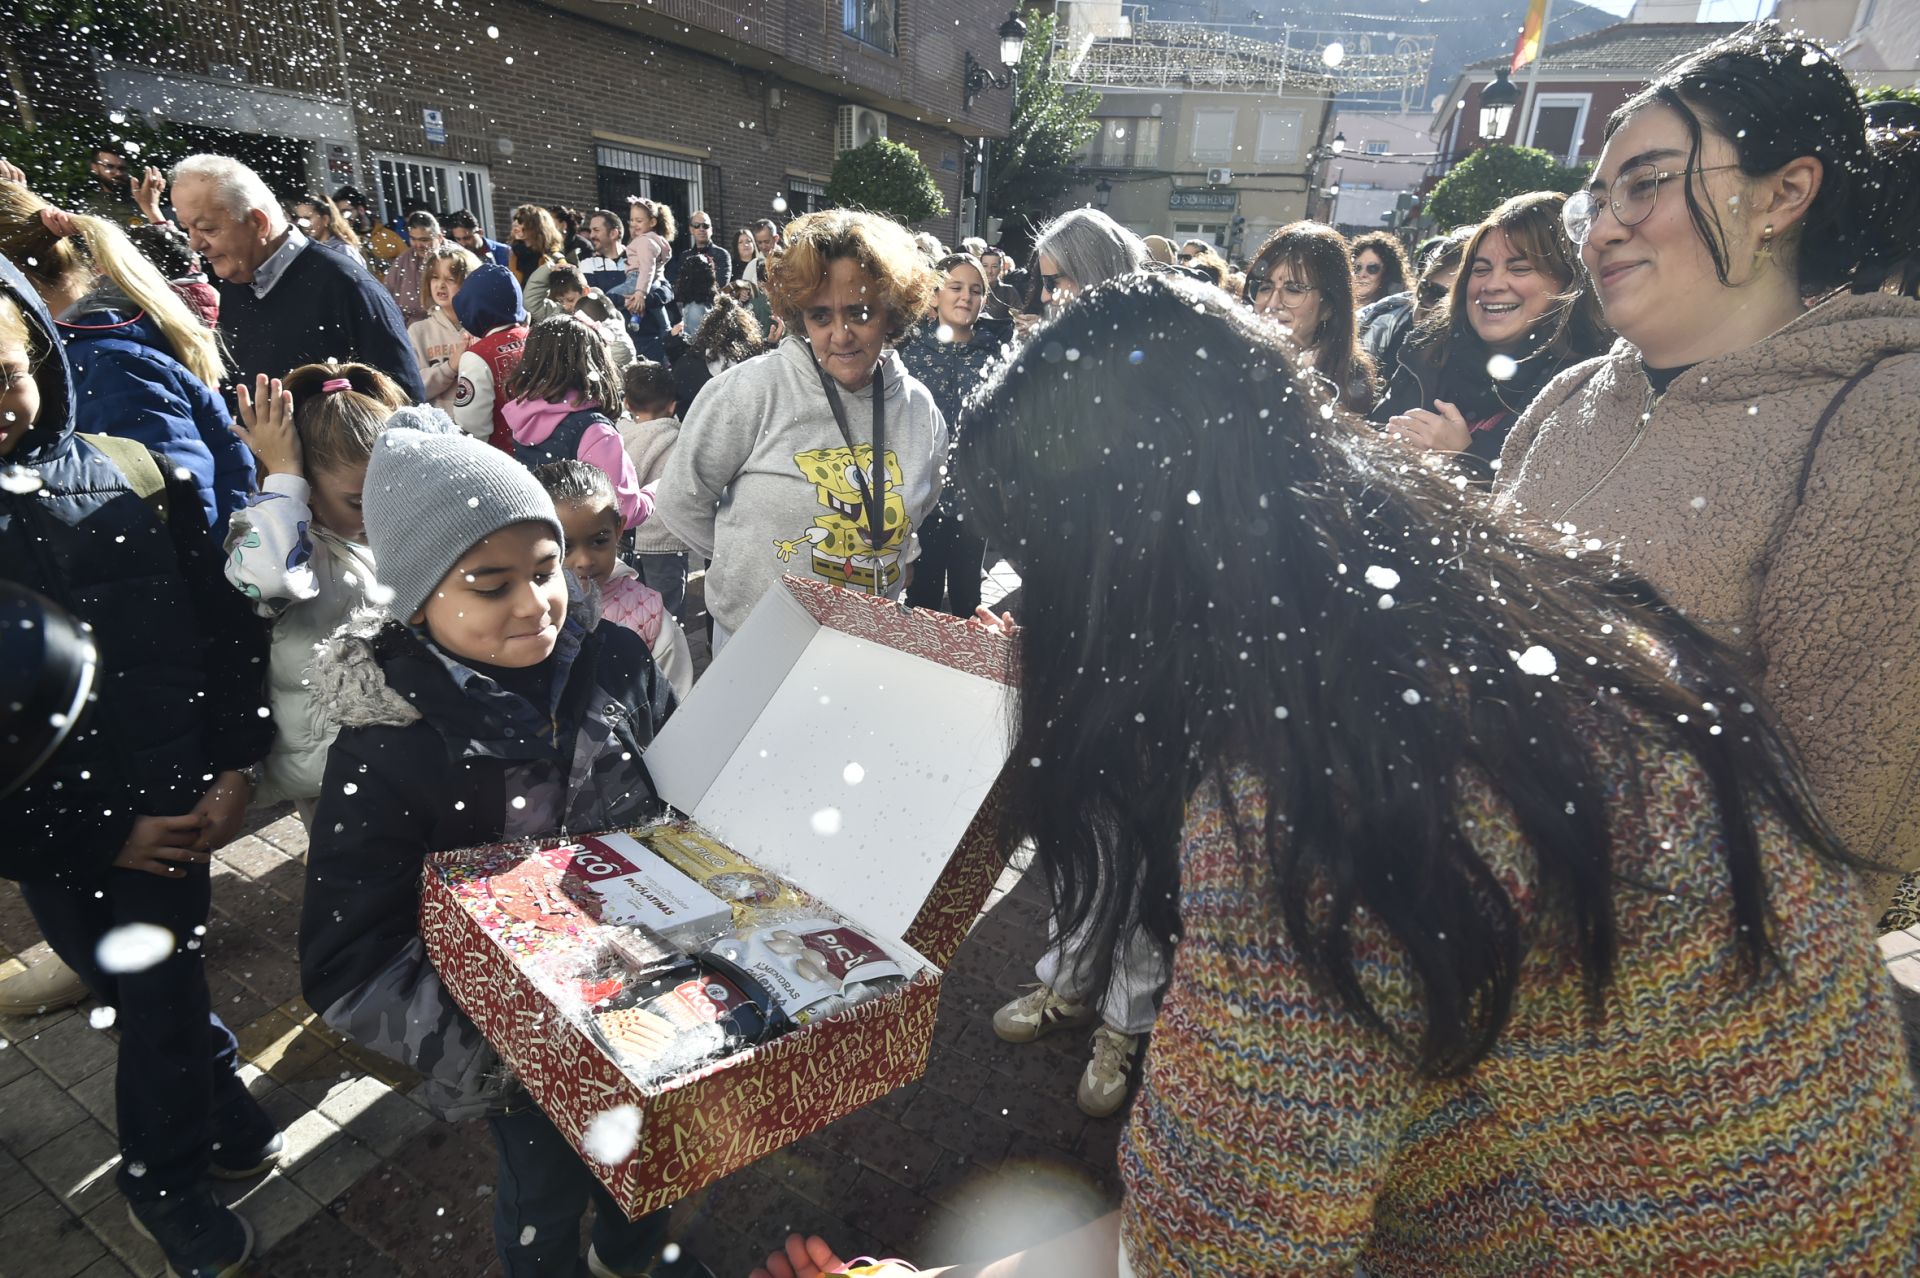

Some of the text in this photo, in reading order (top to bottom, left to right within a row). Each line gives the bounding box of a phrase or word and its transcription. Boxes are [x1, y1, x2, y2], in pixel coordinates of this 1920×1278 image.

[623, 877, 676, 916] PICÓLATINAS
[940, 831, 990, 914] Merry
[753, 961, 801, 1001] ALMENDRAS
[780, 1039, 873, 1125] Christmas
[790, 1024, 867, 1099] Merry
[662, 1083, 776, 1183] Christmas
[674, 1067, 765, 1154] Merry
